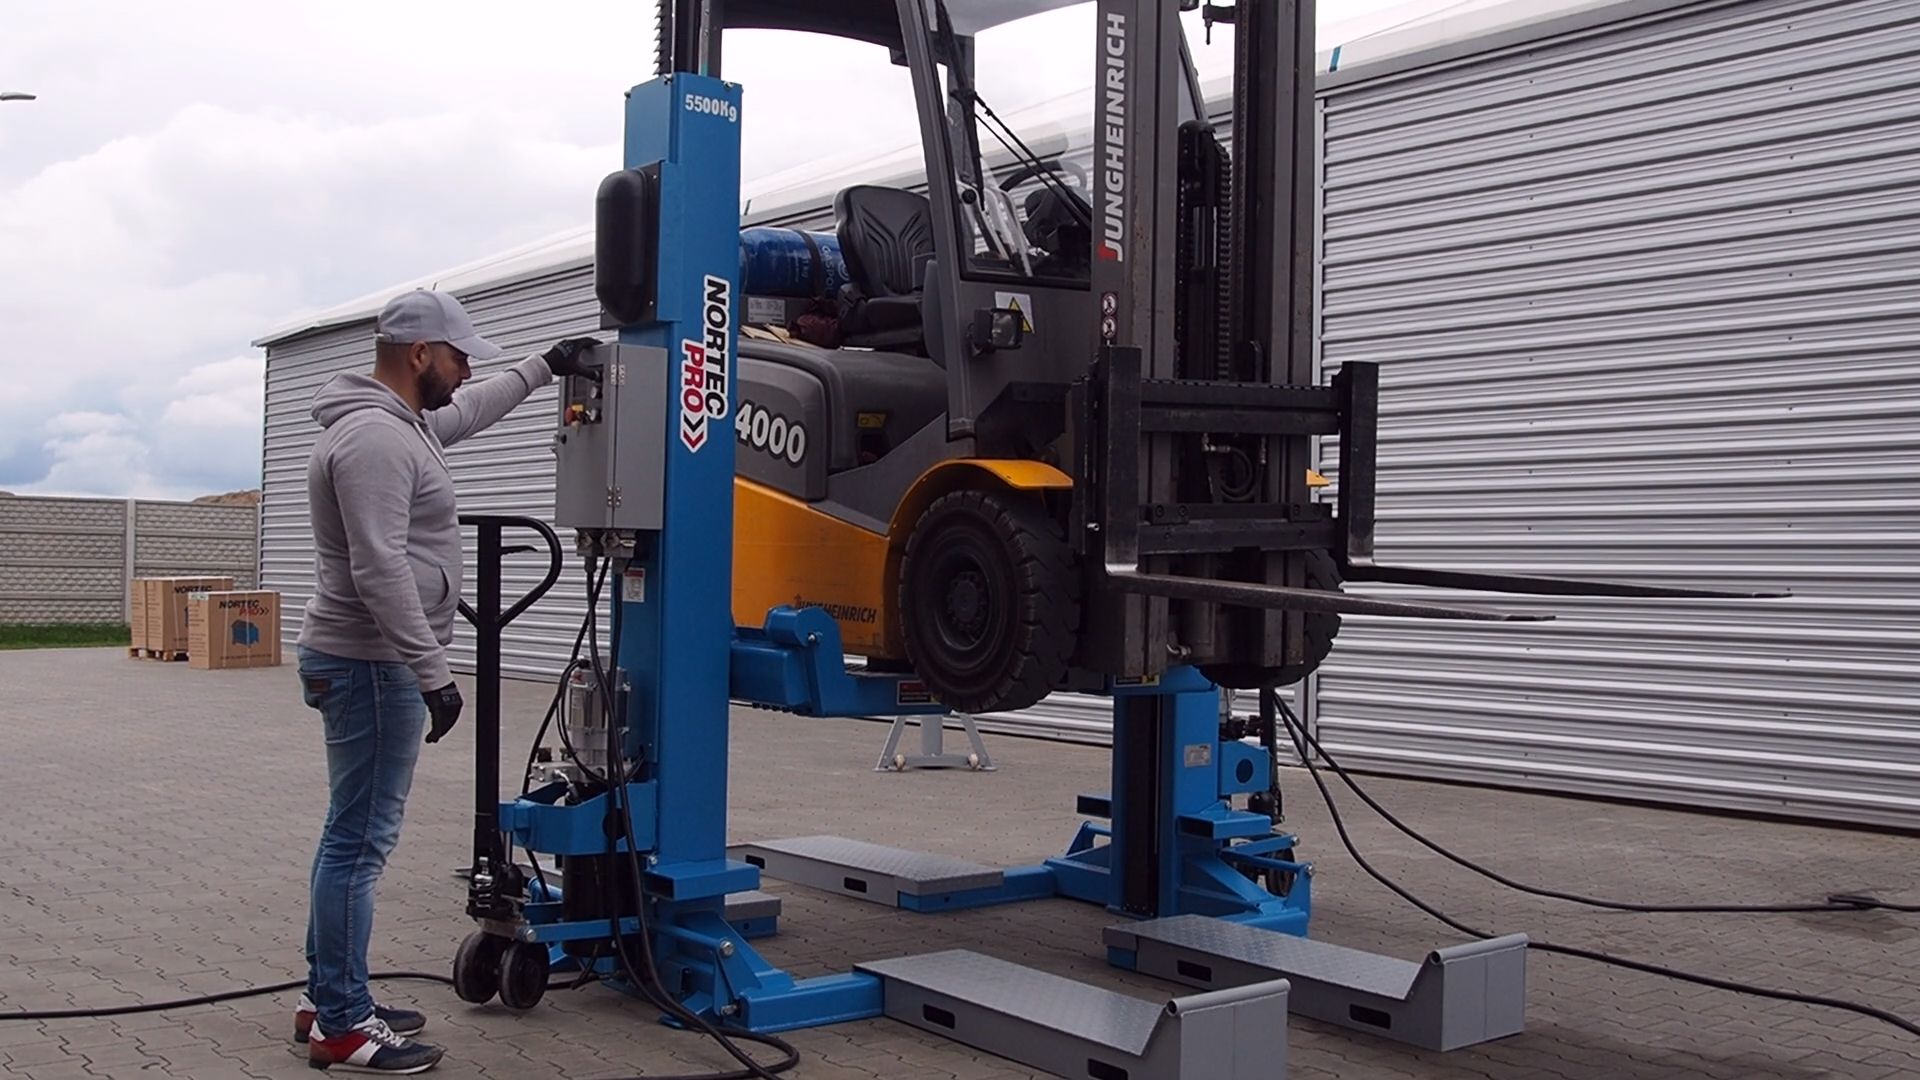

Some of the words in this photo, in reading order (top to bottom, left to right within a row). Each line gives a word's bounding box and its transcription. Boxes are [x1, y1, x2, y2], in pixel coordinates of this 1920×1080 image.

[685, 94, 737, 122] 5500Kg
[1105, 13, 1125, 261] JUNGHEINRICH
[705, 279, 727, 415] NORTEC
[735, 403, 805, 463] 4000
[219, 599, 260, 609] NORTEC
